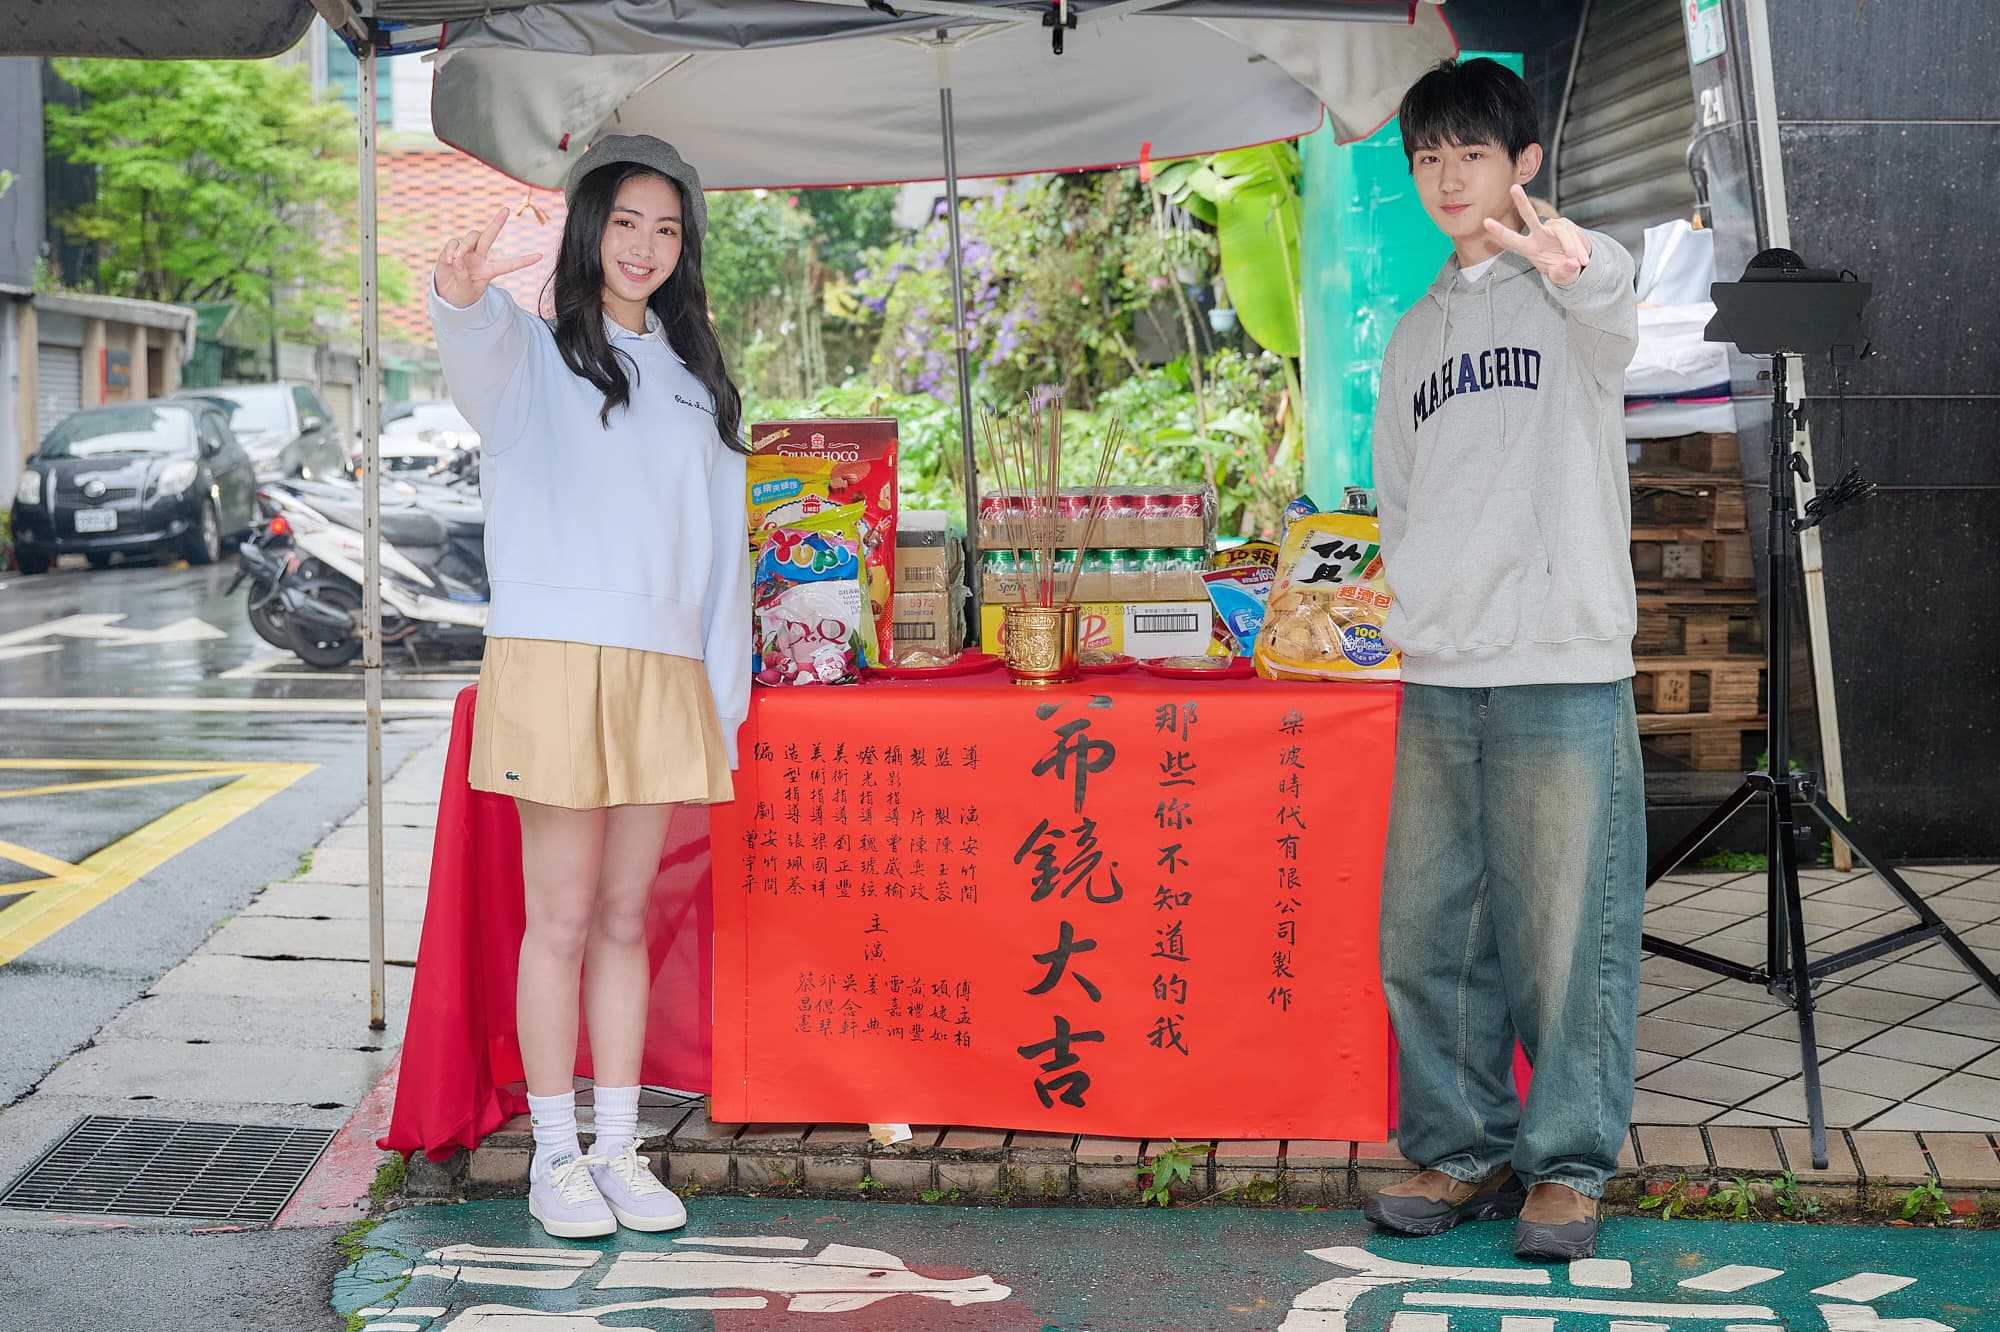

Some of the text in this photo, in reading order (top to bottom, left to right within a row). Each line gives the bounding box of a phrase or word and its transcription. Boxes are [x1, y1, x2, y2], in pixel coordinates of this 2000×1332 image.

[1413, 346, 1541, 433] MAHAGRID
[909, 598, 935, 608] 5972
[1337, 586, 1392, 609] 經濟包
[1146, 701, 1199, 1057] 那些你不知道的我
[863, 913, 889, 962] 主演
